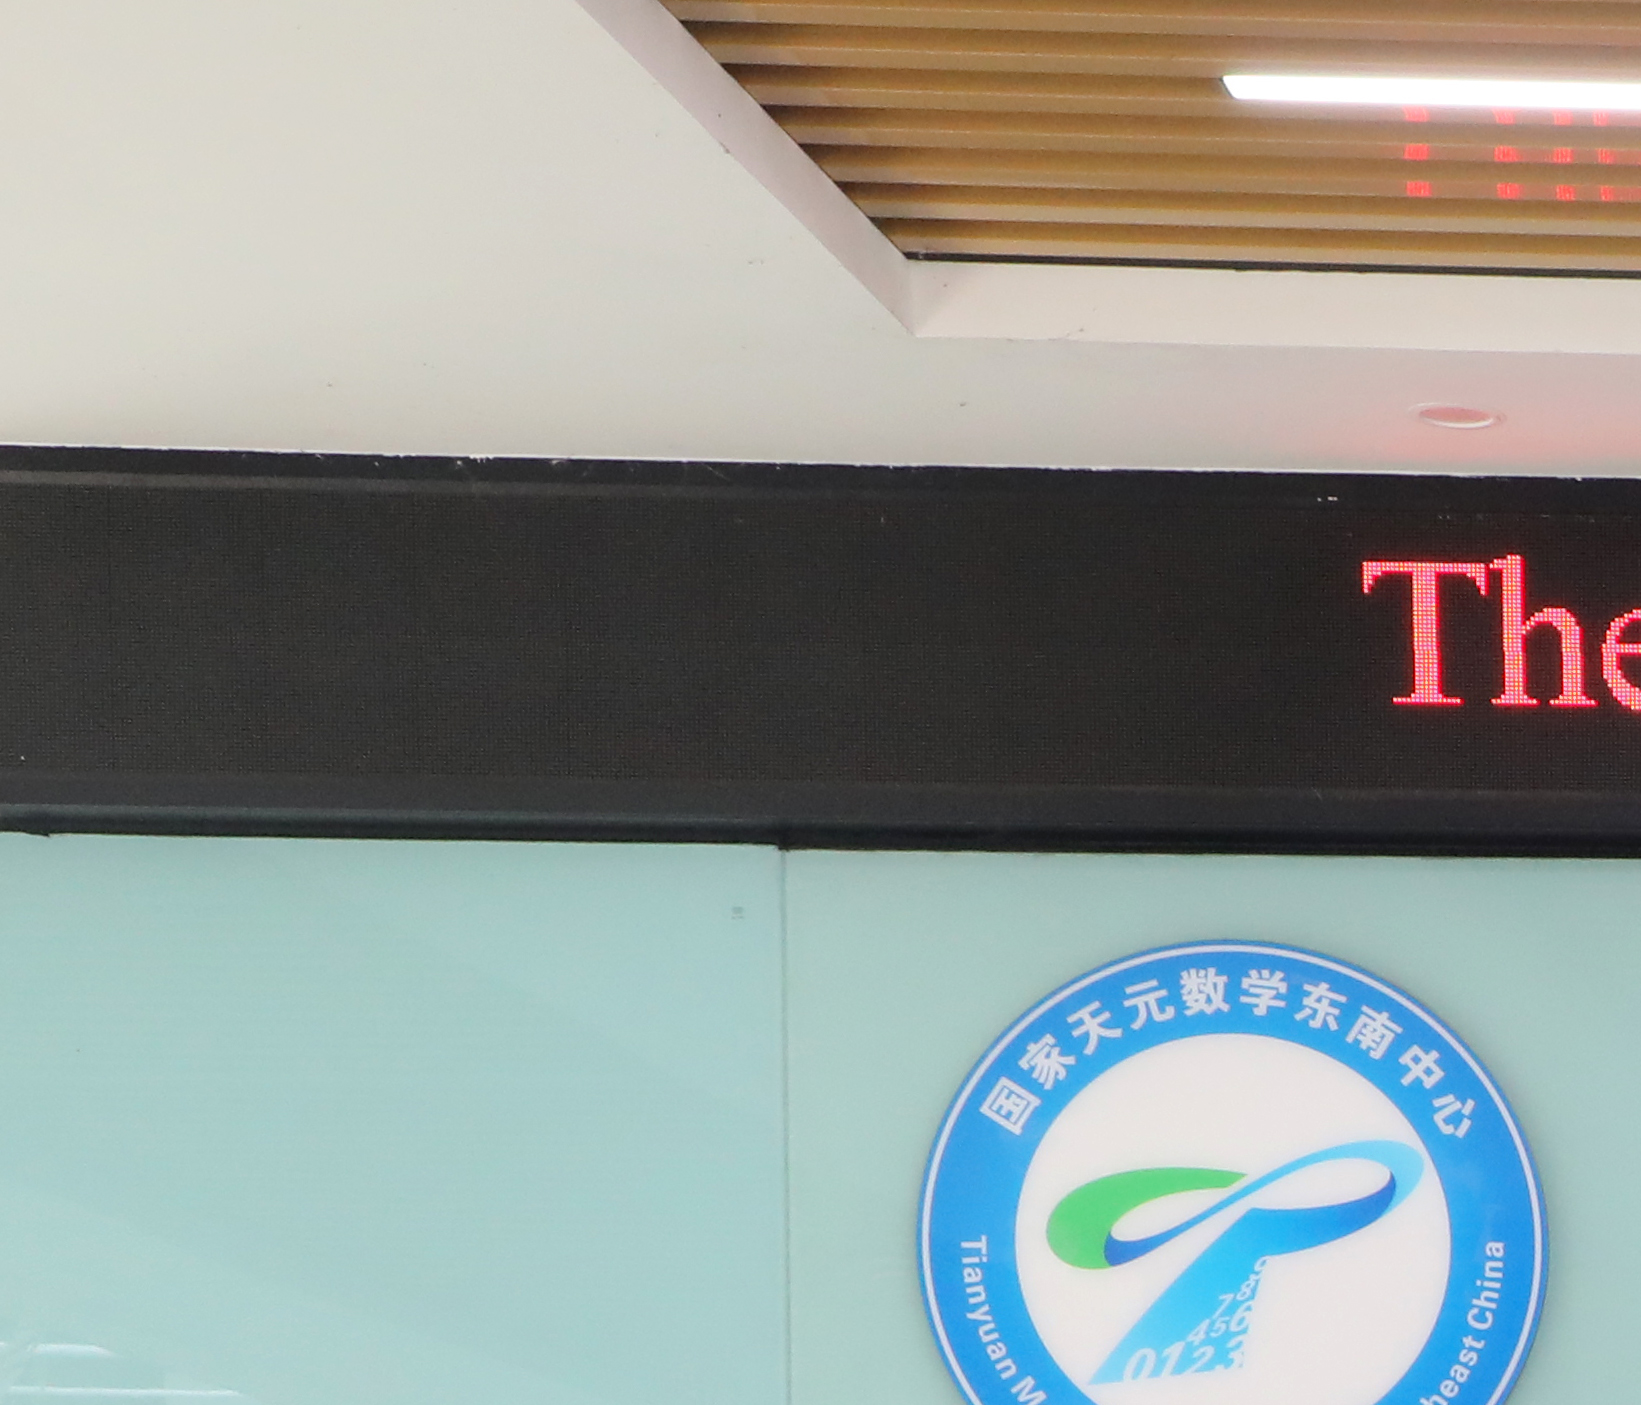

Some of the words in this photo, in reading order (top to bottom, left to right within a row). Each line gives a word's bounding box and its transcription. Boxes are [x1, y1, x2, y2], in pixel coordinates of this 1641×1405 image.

[979, 967, 1475, 1138] 国家天元数学东南中心
[960, 1235, 1018, 1382] Tianyuan
[1465, 1240, 1505, 1331] China
